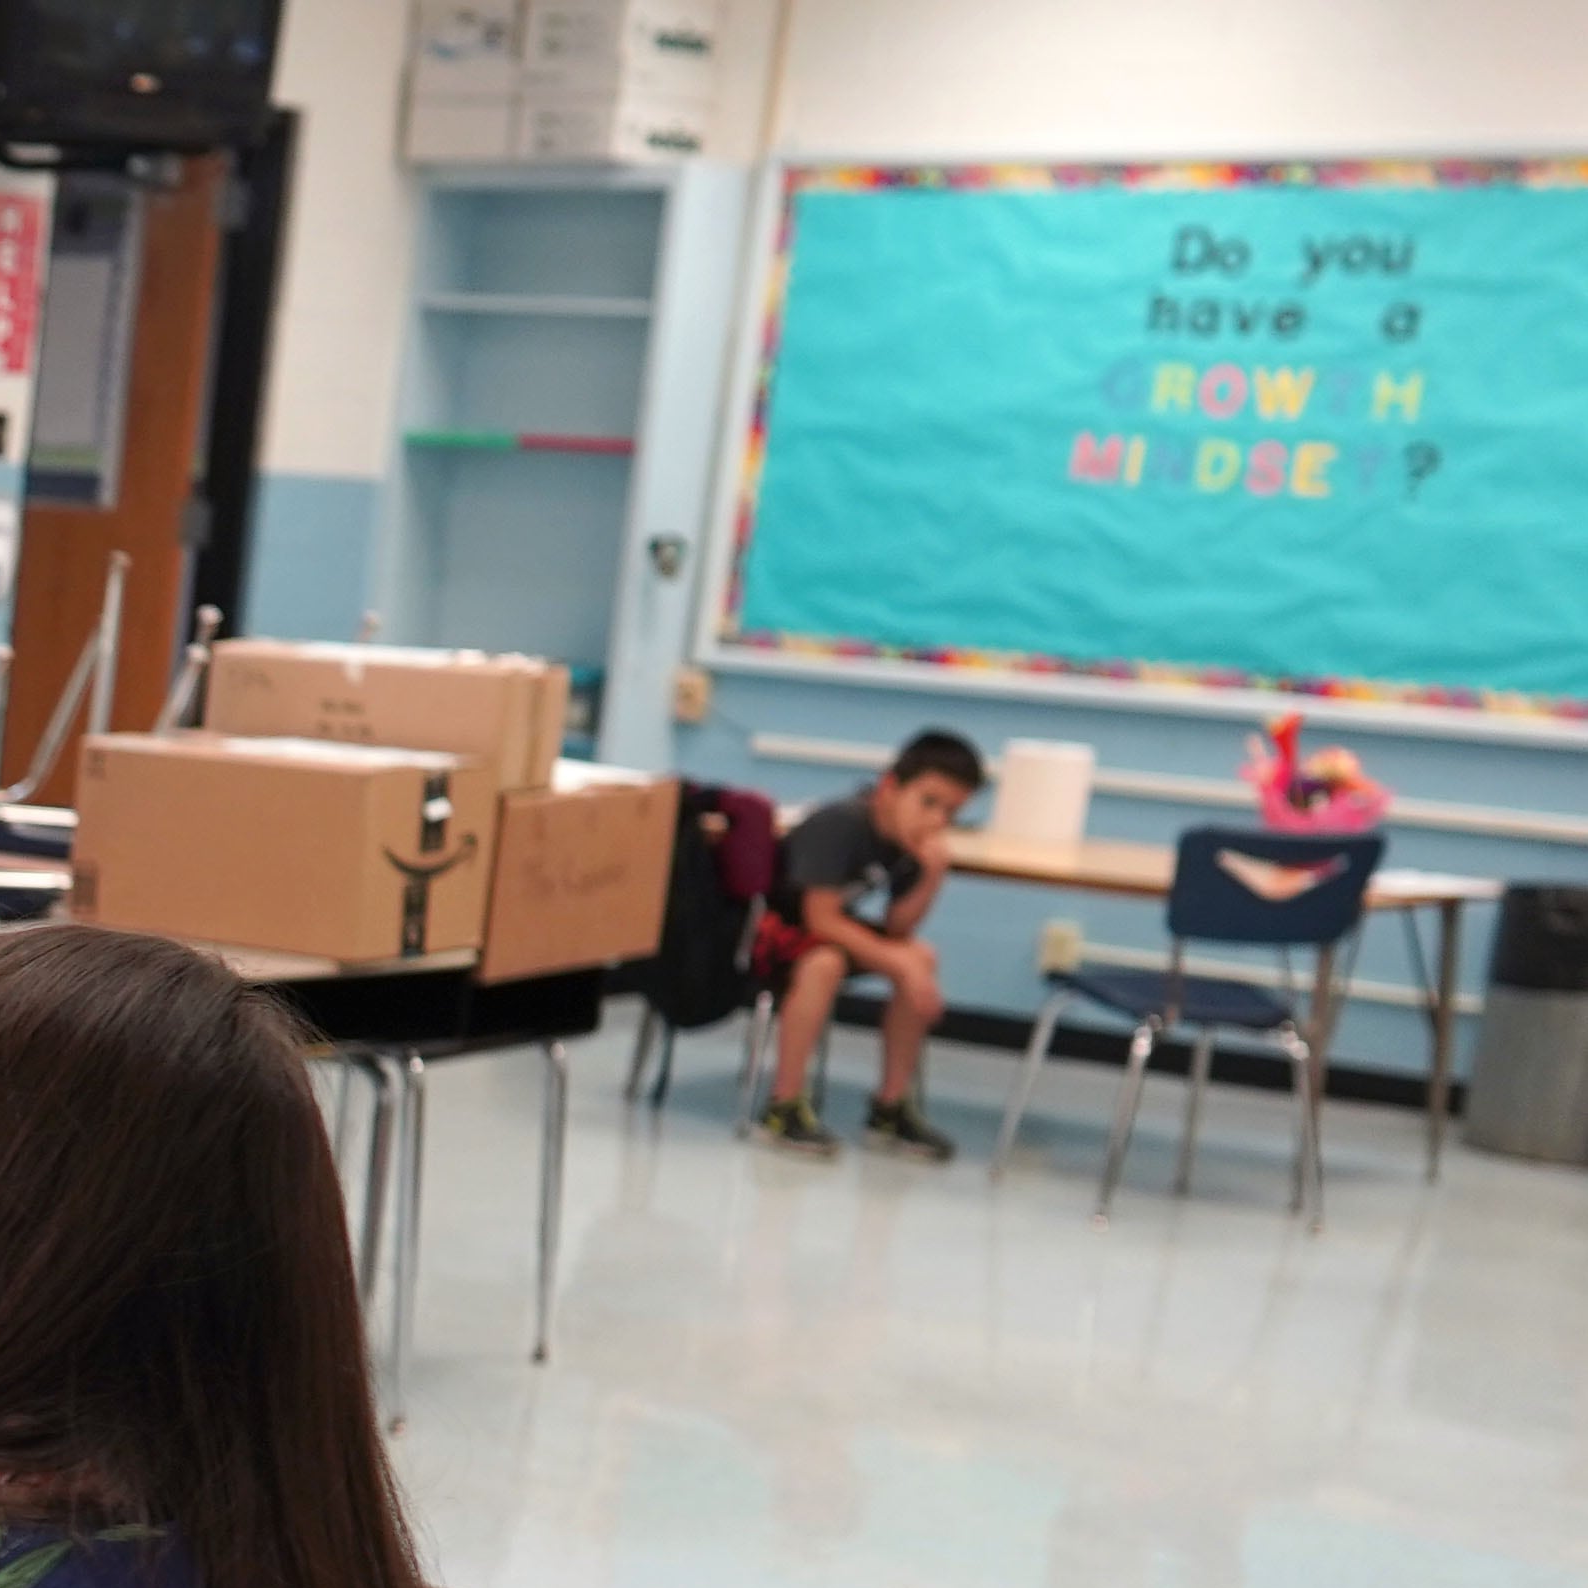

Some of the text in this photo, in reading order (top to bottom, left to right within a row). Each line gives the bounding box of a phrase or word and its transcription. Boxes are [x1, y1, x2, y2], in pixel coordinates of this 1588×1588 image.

[1171, 224, 1416, 289] Do you
[1146, 287, 1422, 344] have a
